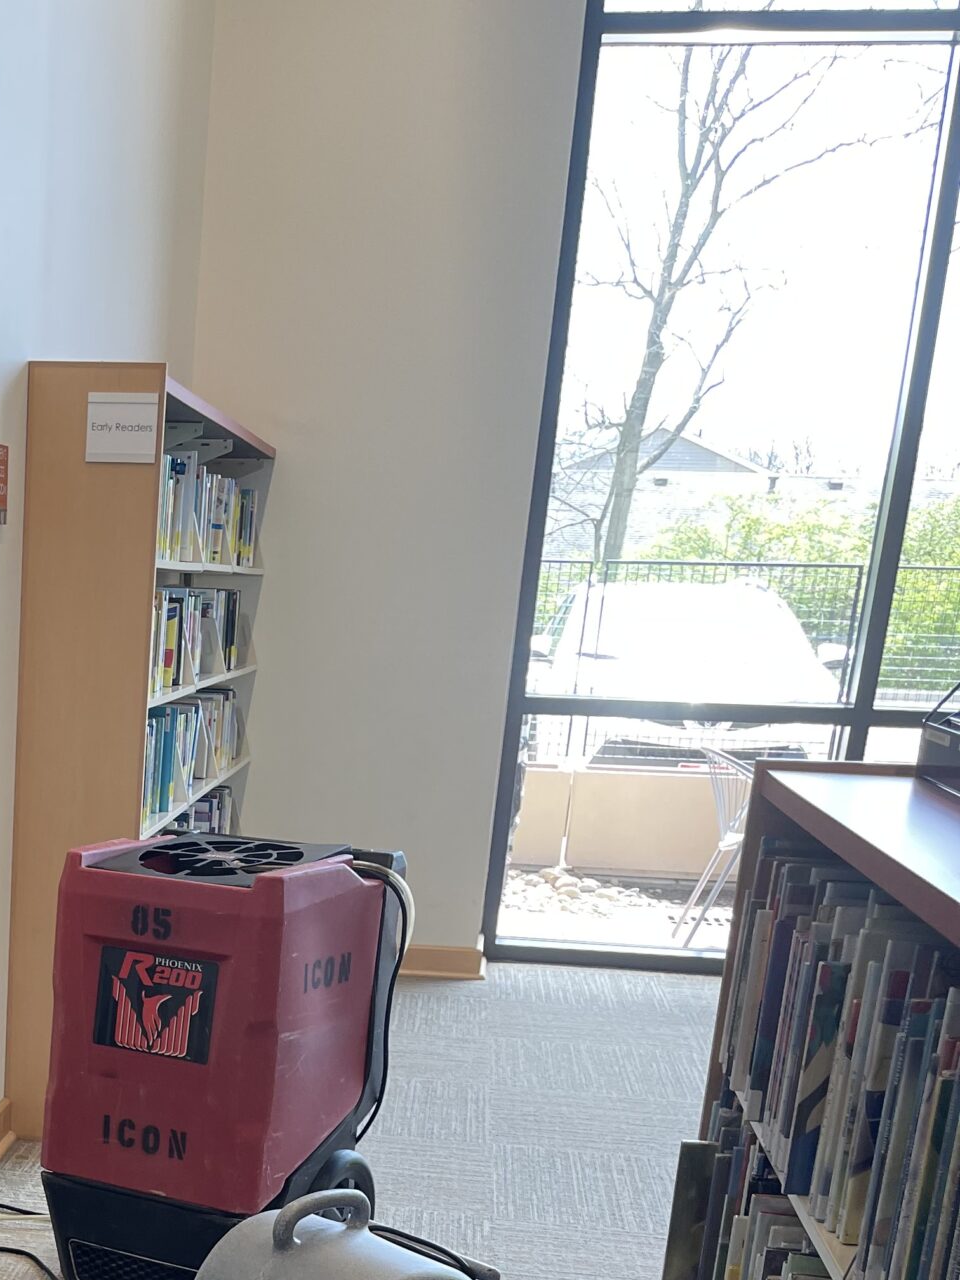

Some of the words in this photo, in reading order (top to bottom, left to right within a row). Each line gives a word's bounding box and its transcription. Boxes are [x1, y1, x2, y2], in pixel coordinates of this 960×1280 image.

[91, 422, 112, 432] Early
[115, 423, 153, 432] Readers
[155, 957, 202, 972] PHOENIX
[304, 951, 352, 993] ICON
[103, 1114, 187, 1160] ICON
